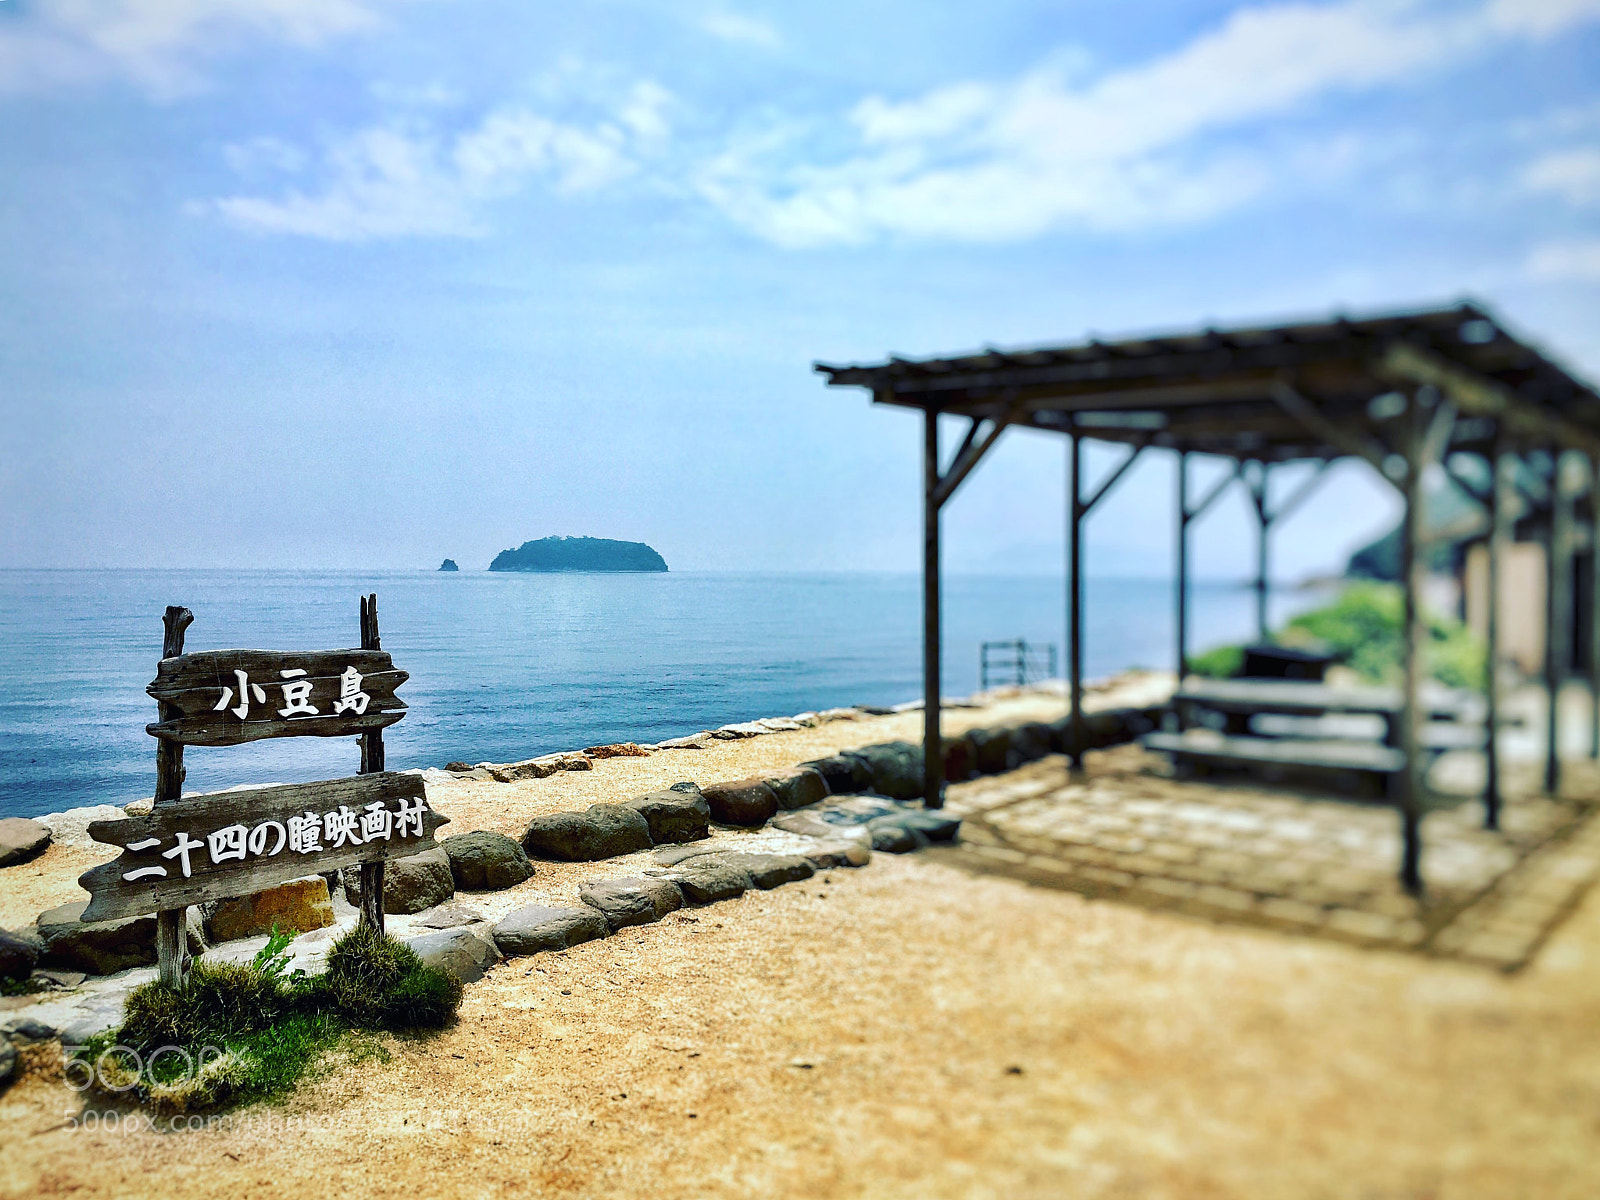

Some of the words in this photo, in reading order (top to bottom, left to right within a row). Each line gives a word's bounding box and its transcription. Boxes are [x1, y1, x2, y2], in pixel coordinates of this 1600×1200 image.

[213, 666, 371, 720] 小豆島
[122, 796, 428, 882] 二十四の瞳映画村
